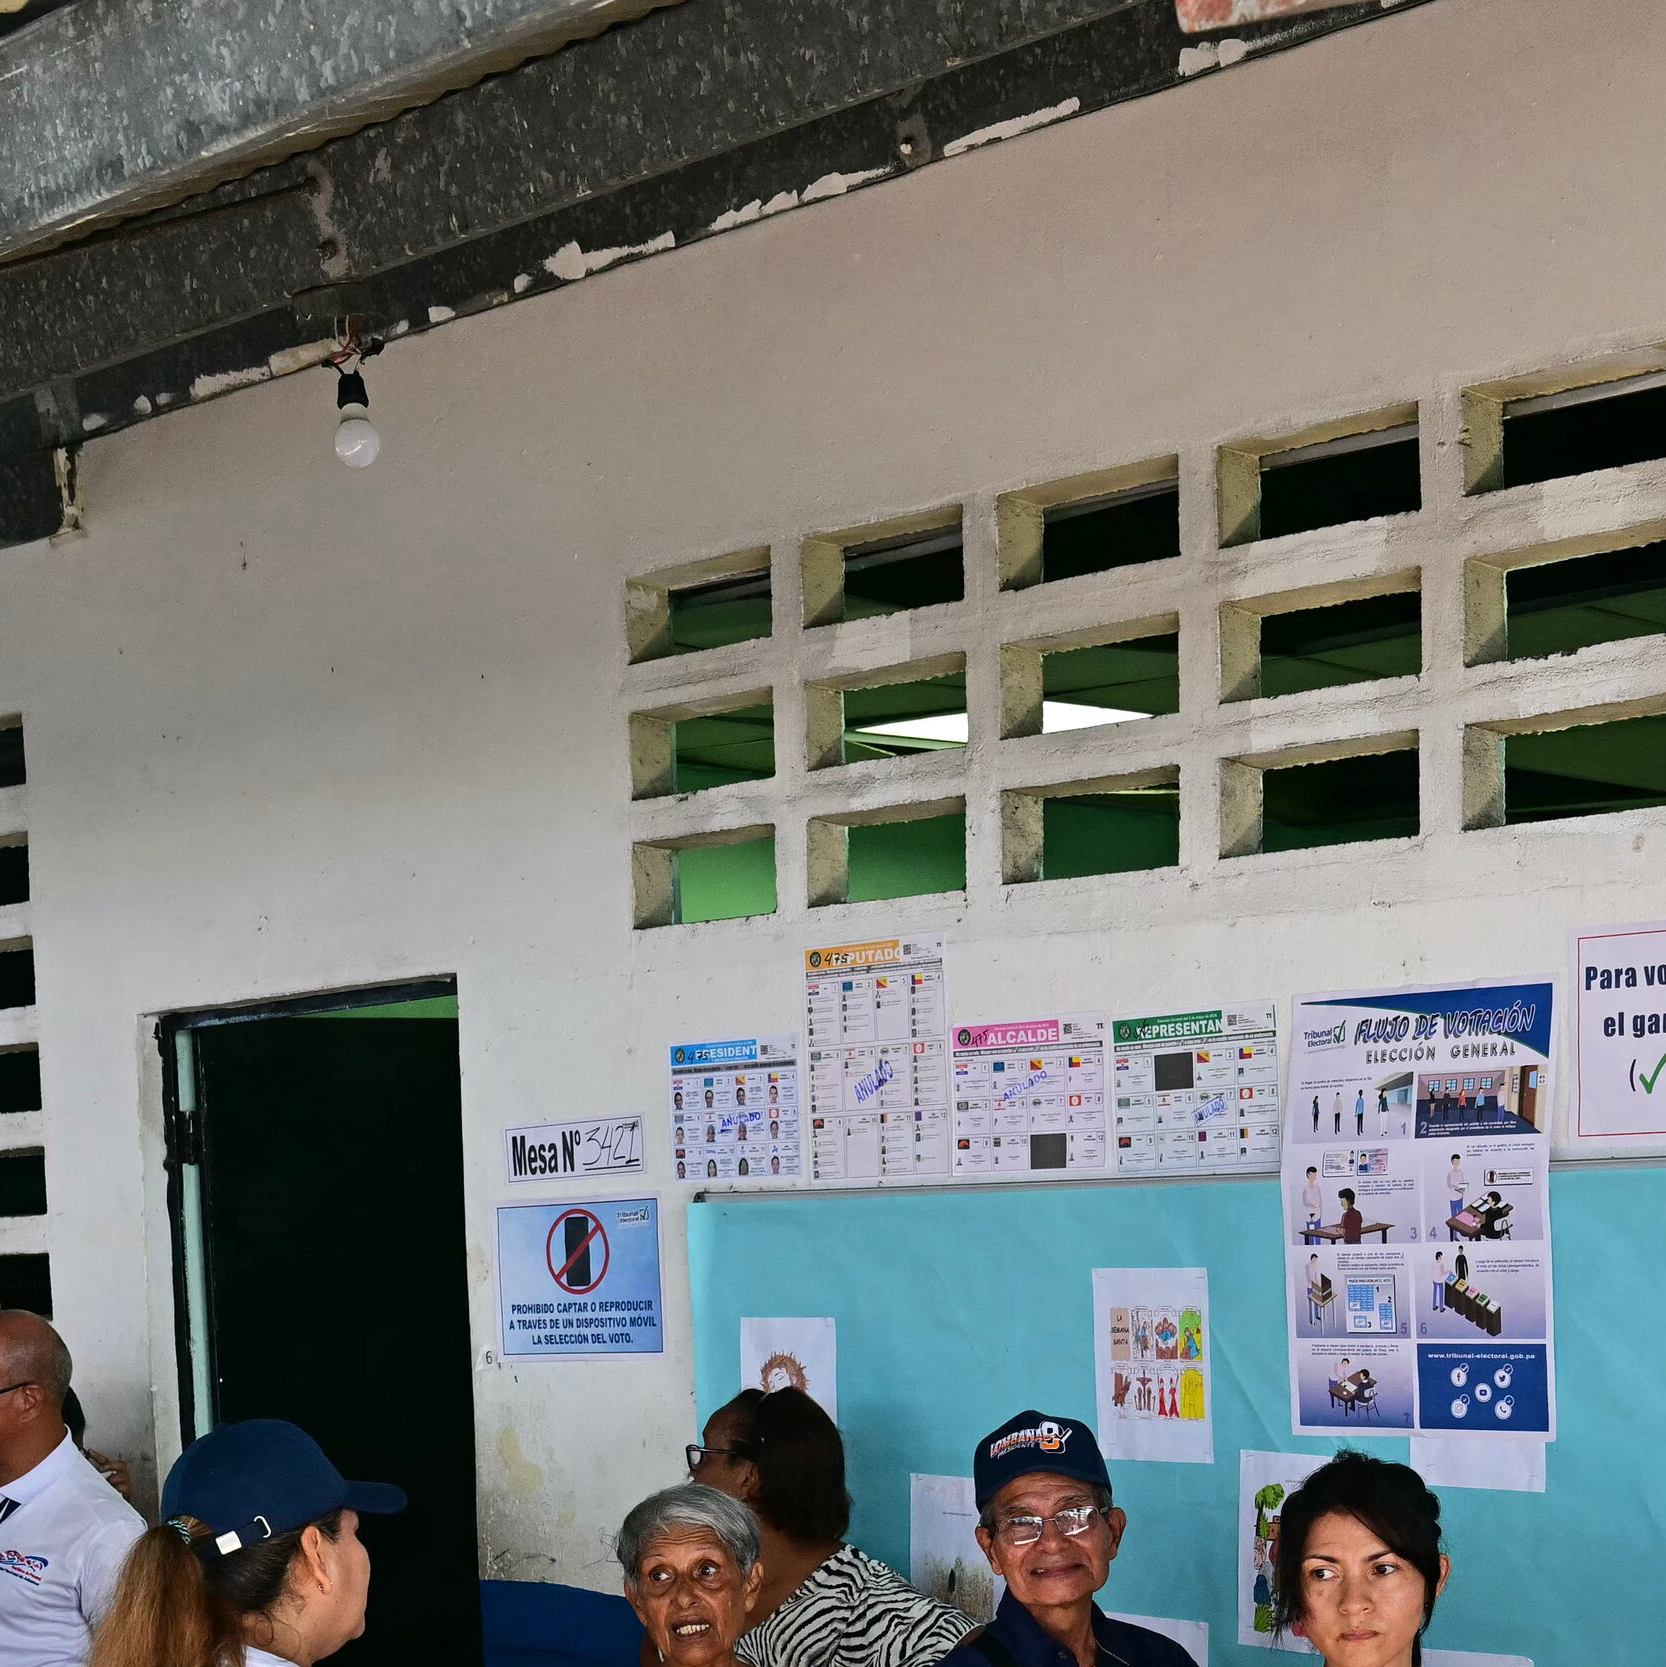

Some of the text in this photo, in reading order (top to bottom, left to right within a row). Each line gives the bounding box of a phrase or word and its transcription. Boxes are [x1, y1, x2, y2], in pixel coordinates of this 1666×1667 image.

[824, 952, 849, 966] 475
[1585, 966, 1638, 991] Para
[1354, 1000, 1536, 1044] FLUJO DE VOTACIÓN
[1603, 1012, 1624, 1037] el
[986, 1028, 1058, 1046] ALCALDE
[1303, 1027, 1332, 1040] Tribunal
[1308, 1037, 1332, 1048] Electoral
[1366, 1042, 1436, 1064] ELECCIÓN
[1451, 1042, 1516, 1058] GENERAL
[1003, 1070, 1048, 1101] ANULADO
[1401, 1122, 1407, 1135] 1
[1420, 1122, 1427, 1134] 2
[511, 1135, 559, 1176] Mesa
[1411, 1228, 1417, 1239] 3
[1429, 1227, 1437, 1239] 4
[511, 1300, 653, 1315] PROHIBIDO CAPTAR O REPRODUCIR
[509, 1314, 657, 1330] A TRAVÉS DE UN DISPOSITIVO MÓVIL
[1400, 1322, 1407, 1335] 5
[1420, 1322, 1427, 1335] 6
[532, 1331, 633, 1345] LA SELECCIÓN DEL VOTO.
[485, 1351, 493, 1364] 6
[1427, 1352, 1536, 1360] www.tribunal-electoral.gob.pa
